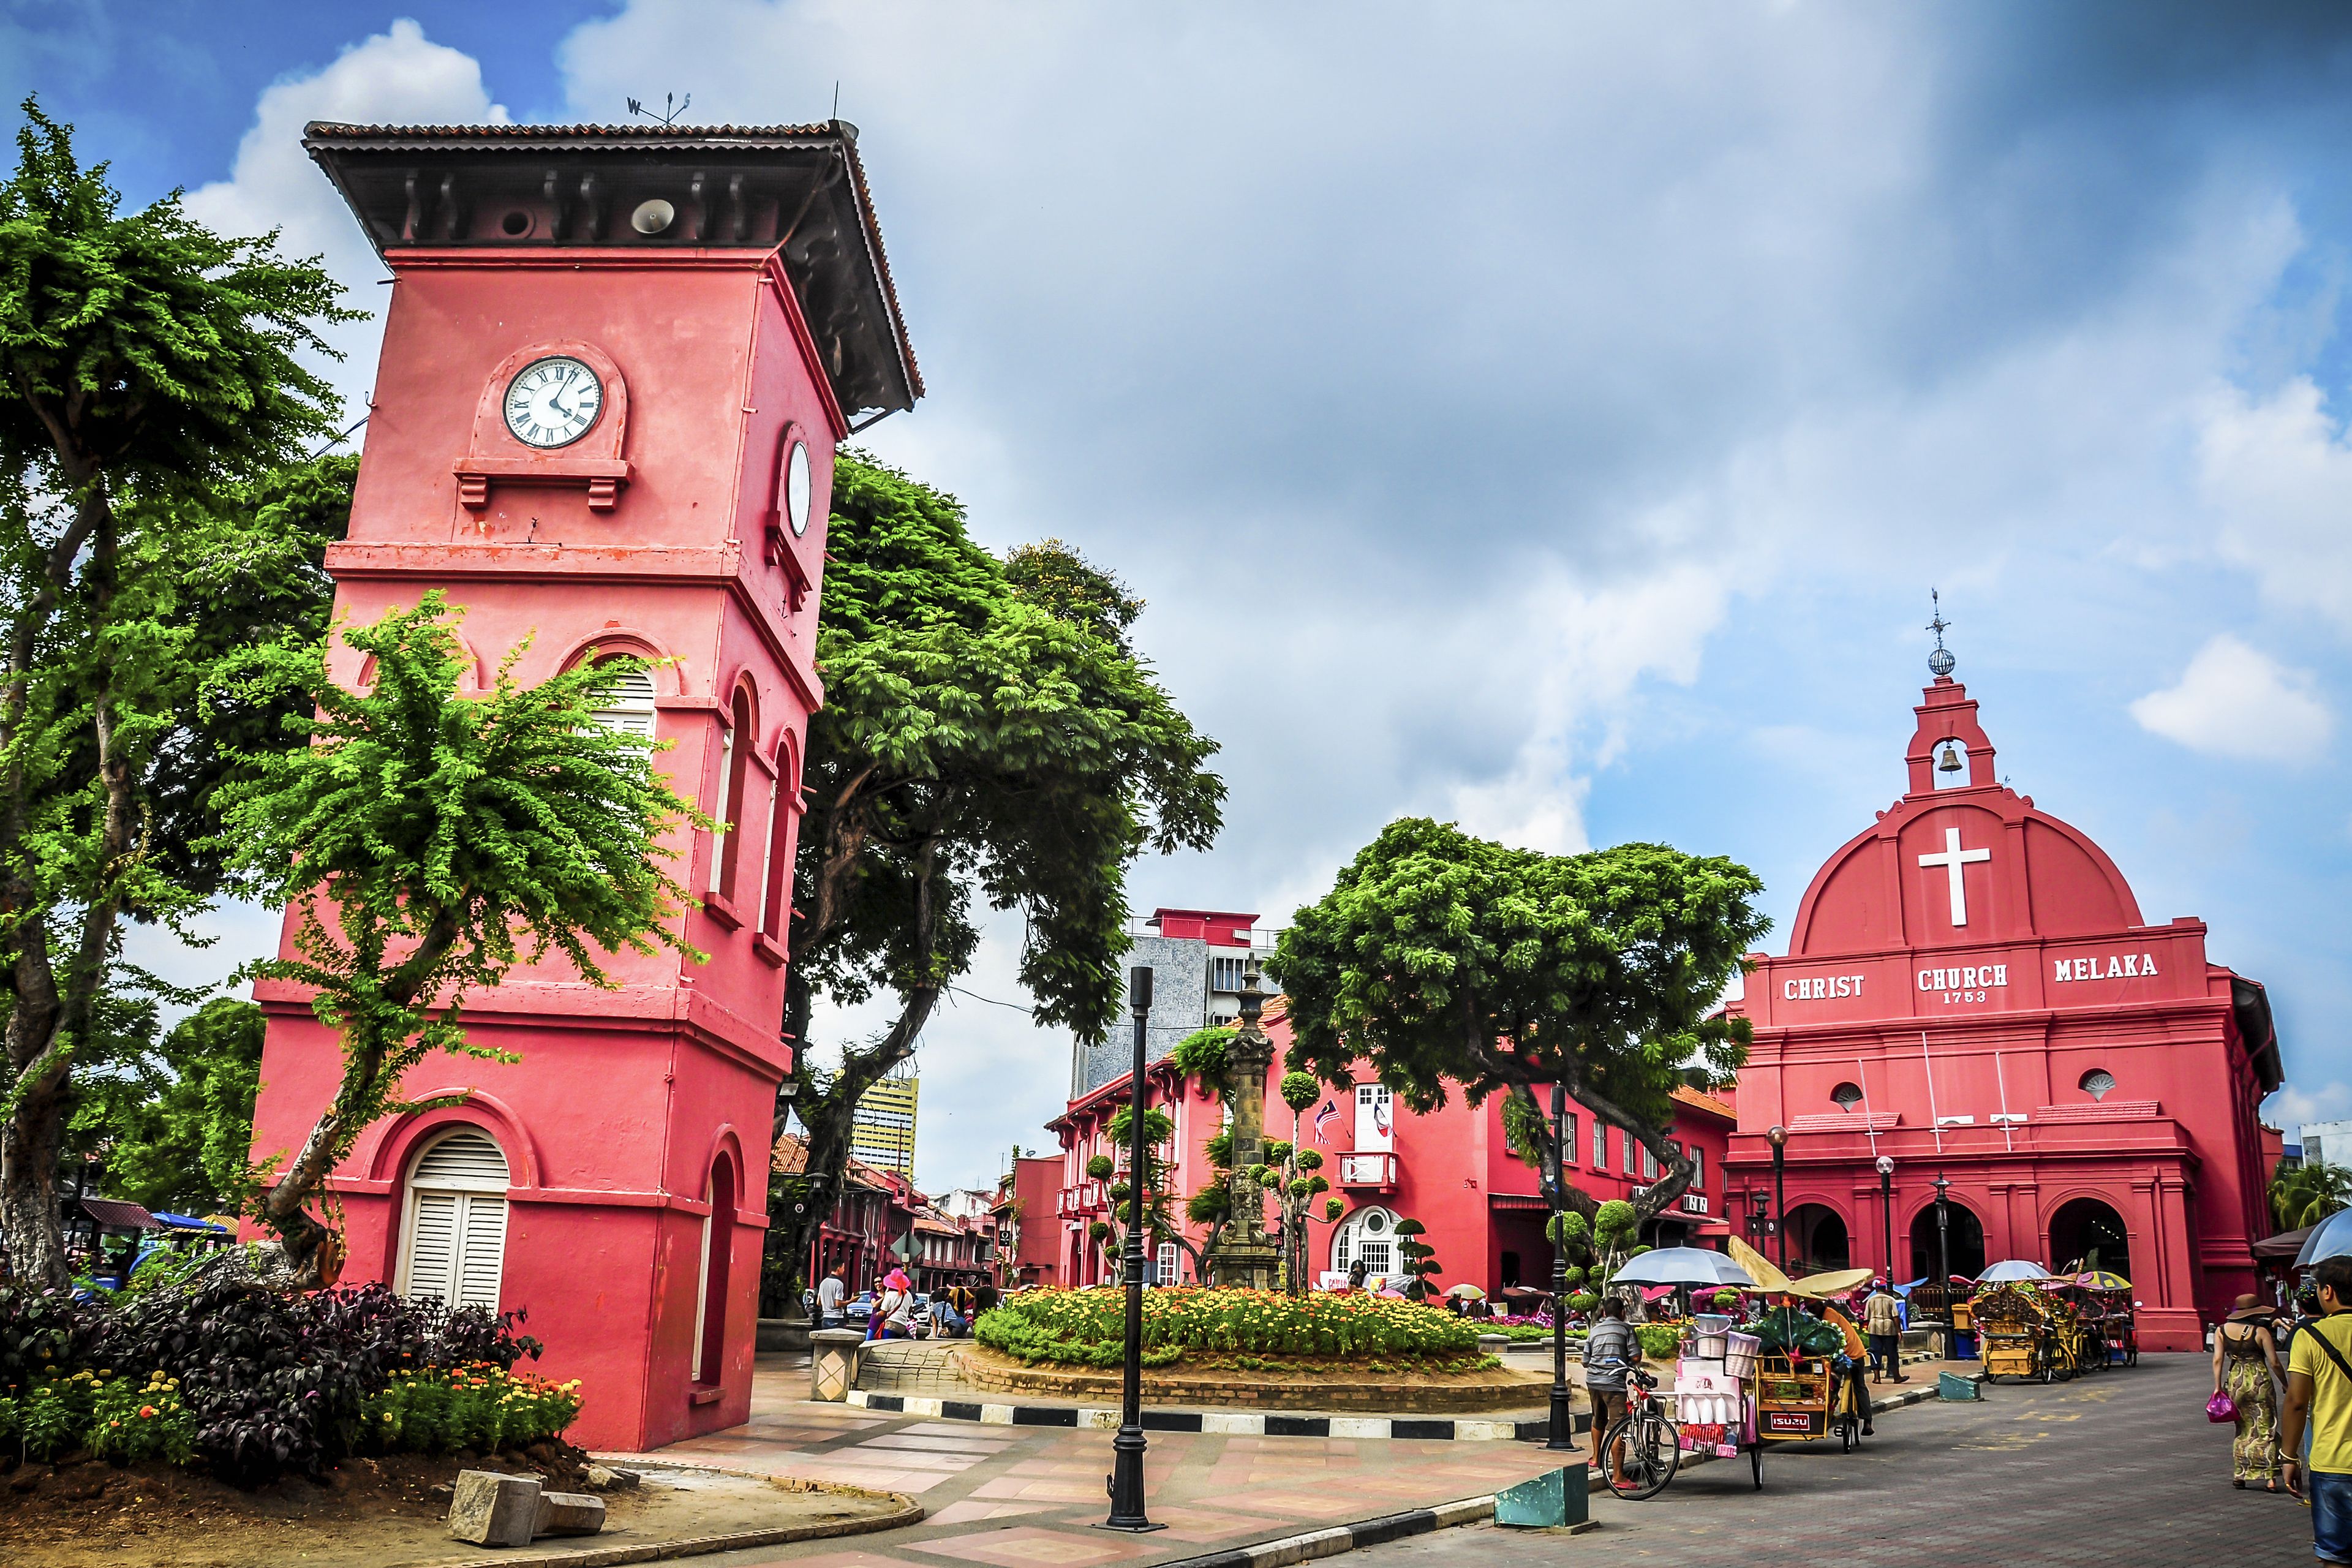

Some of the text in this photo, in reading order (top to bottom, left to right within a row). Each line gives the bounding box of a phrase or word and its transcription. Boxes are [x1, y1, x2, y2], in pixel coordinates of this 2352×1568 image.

[627, 97, 641, 116] W
[684, 92, 691, 110] S
[536, 370, 549, 385] XI
[554, 367, 565, 380] XII
[521, 383, 535, 394] X
[527, 423, 540, 439] VII
[546, 428, 554, 442] VI
[564, 426, 572, 439] V
[1784, 954, 2158, 1000] CHRIST CHURCH MELAKA
[1943, 990, 1986, 1004] 1753
